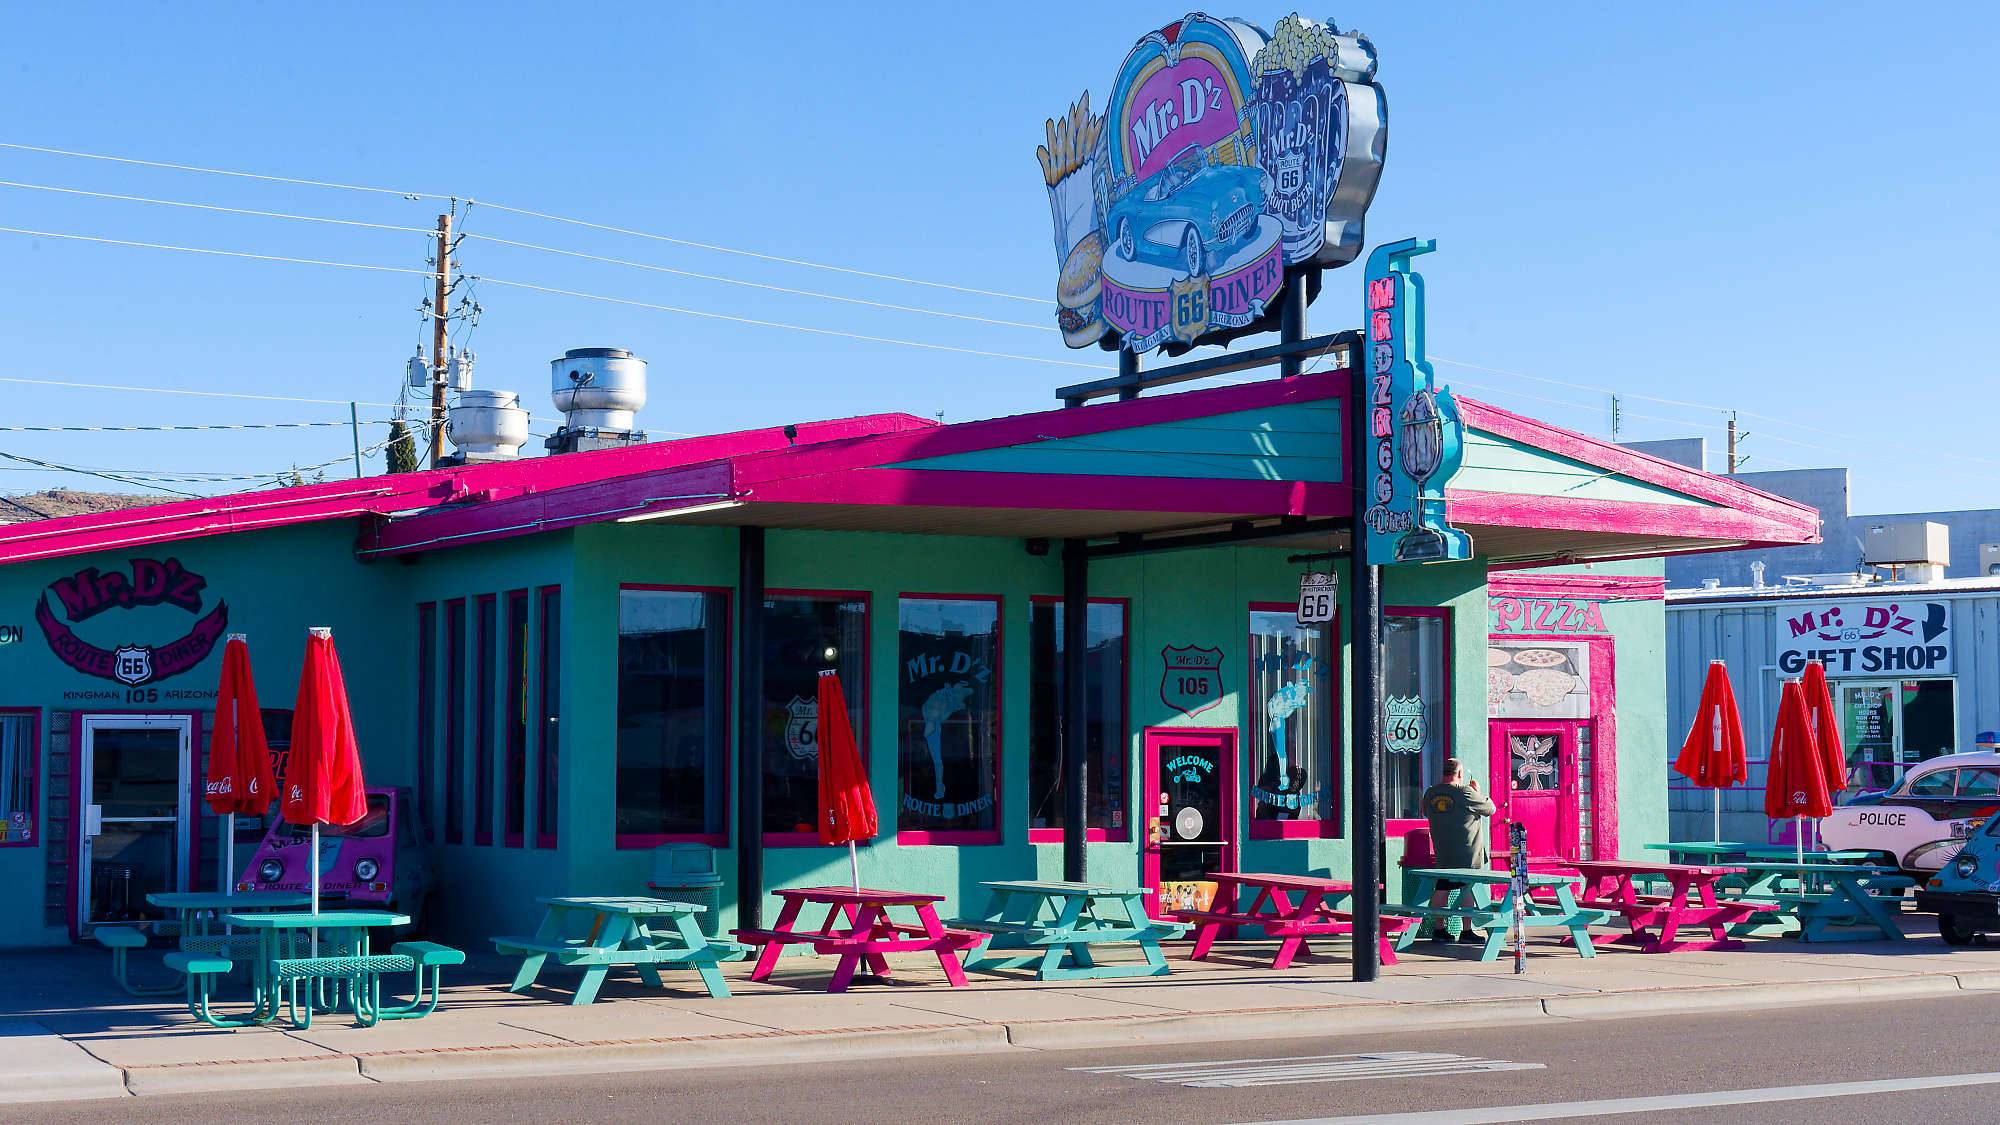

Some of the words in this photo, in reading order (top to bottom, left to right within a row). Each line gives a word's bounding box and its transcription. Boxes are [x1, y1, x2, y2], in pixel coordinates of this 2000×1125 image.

[1131, 98, 1179, 168] Mr.
[1177, 76, 1223, 126] D'z
[1271, 128, 1295, 157] Mr.
[1280, 158, 1301, 168] ROUTE
[1281, 170, 1299, 189] 66
[1269, 192, 1290, 213] ROOT
[1291, 182, 1313, 213] BEER
[1104, 286, 1166, 331] ROUTE
[1177, 289, 1204, 327] 66
[1211, 256, 1277, 313] DINER
[1212, 313, 1250, 327] ARIZONA
[1302, 594, 1329, 618] 66
[1488, 598, 1608, 633] PIZZA
[1786, 607, 1843, 638] Mr.
[1863, 604, 1915, 636] D'z
[1844, 631, 1857, 640] 66
[55, 633, 111, 672] ROUTE
[122, 658, 144, 675] 66
[159, 633, 211, 667] DINER
[1176, 656, 1192, 665] Mr.
[1861, 645, 1948, 672] SHOP
[907, 653, 945, 683] Mr.
[949, 651, 992, 683] D'z
[64, 690, 120, 699] KINGMAN
[126, 688, 158, 704] 105
[1177, 677, 1209, 695] 105
[800, 720, 819, 745] 6
[1395, 718, 1419, 740] 66
[1166, 755, 1214, 773] WELCOME
[903, 793, 942, 817] ROUTE
[1859, 812, 1906, 826] POLICE
[264, 882, 304, 890] ROUTE
[323, 882, 362, 890] DINER
